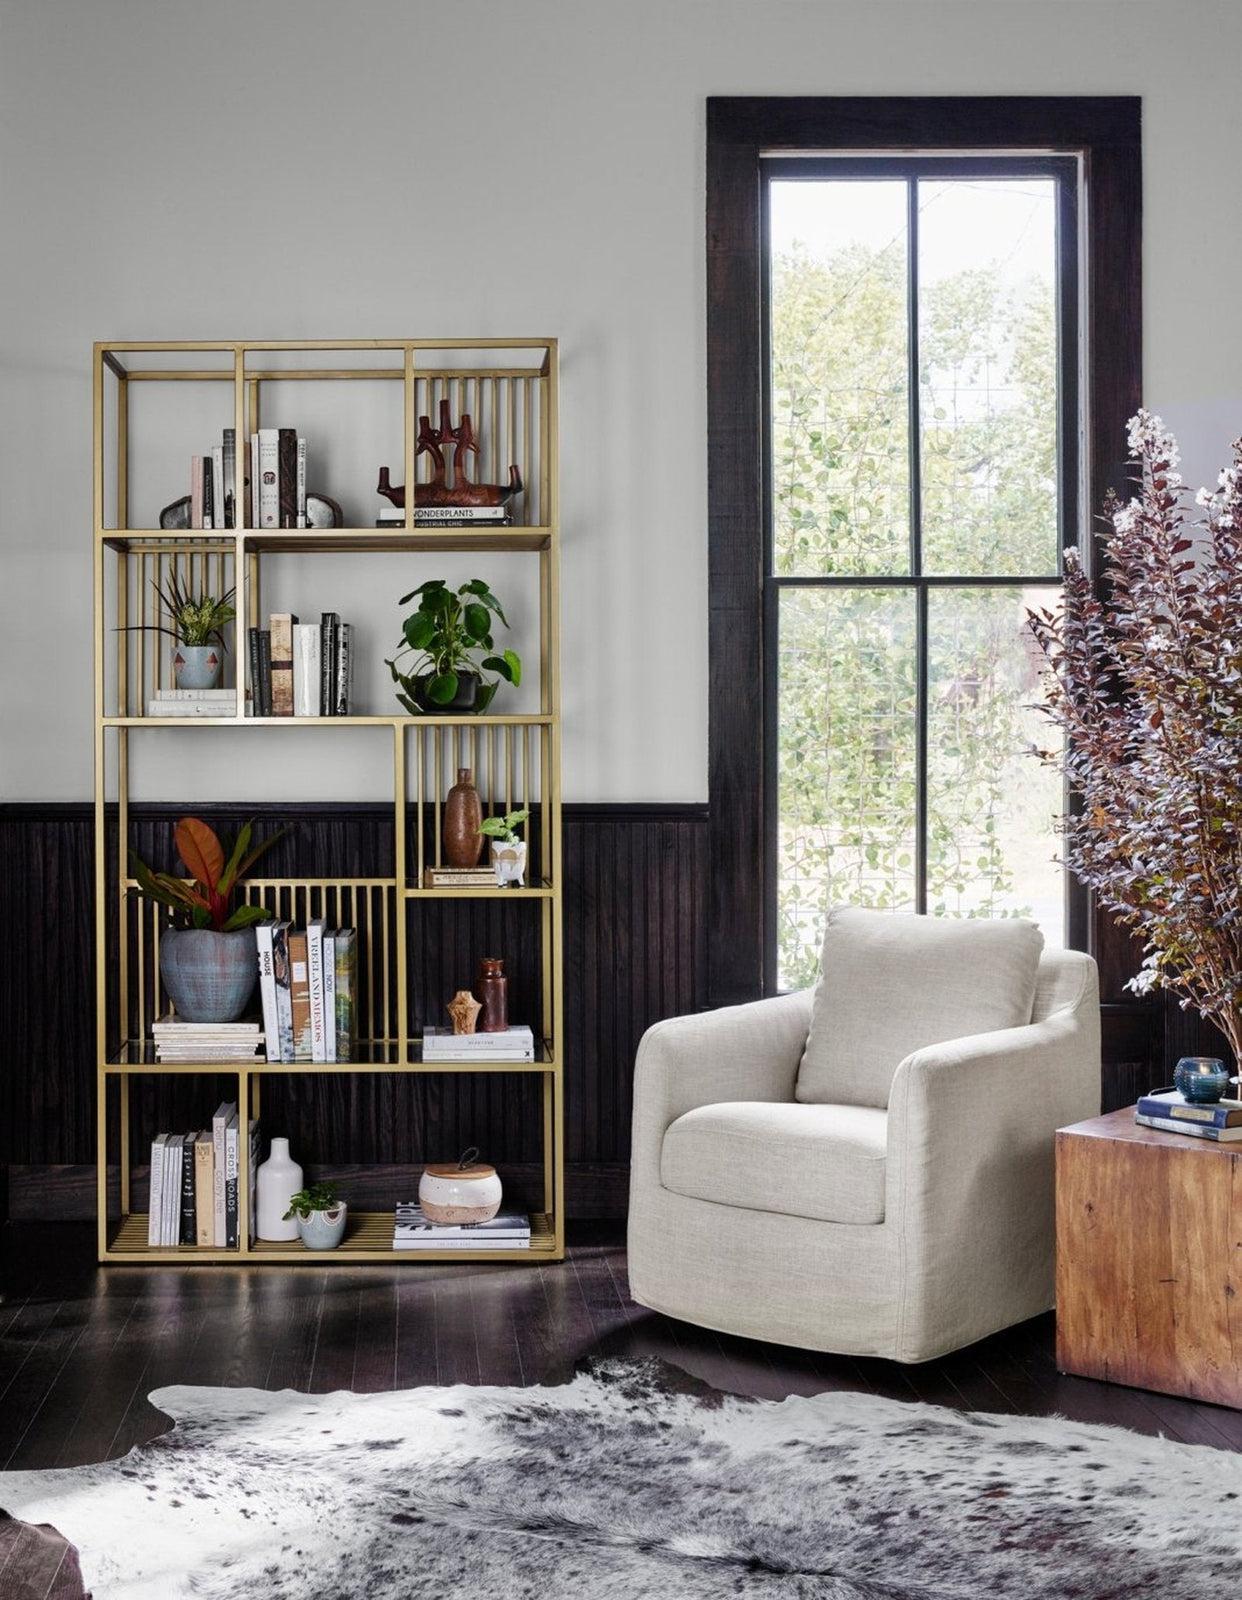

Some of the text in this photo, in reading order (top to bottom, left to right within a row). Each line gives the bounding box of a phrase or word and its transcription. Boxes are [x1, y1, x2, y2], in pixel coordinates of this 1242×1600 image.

[263, 951, 271, 976] HOUSE
[325, 974, 333, 993] NOW
[227, 1146, 235, 1213] CROSSROADS
